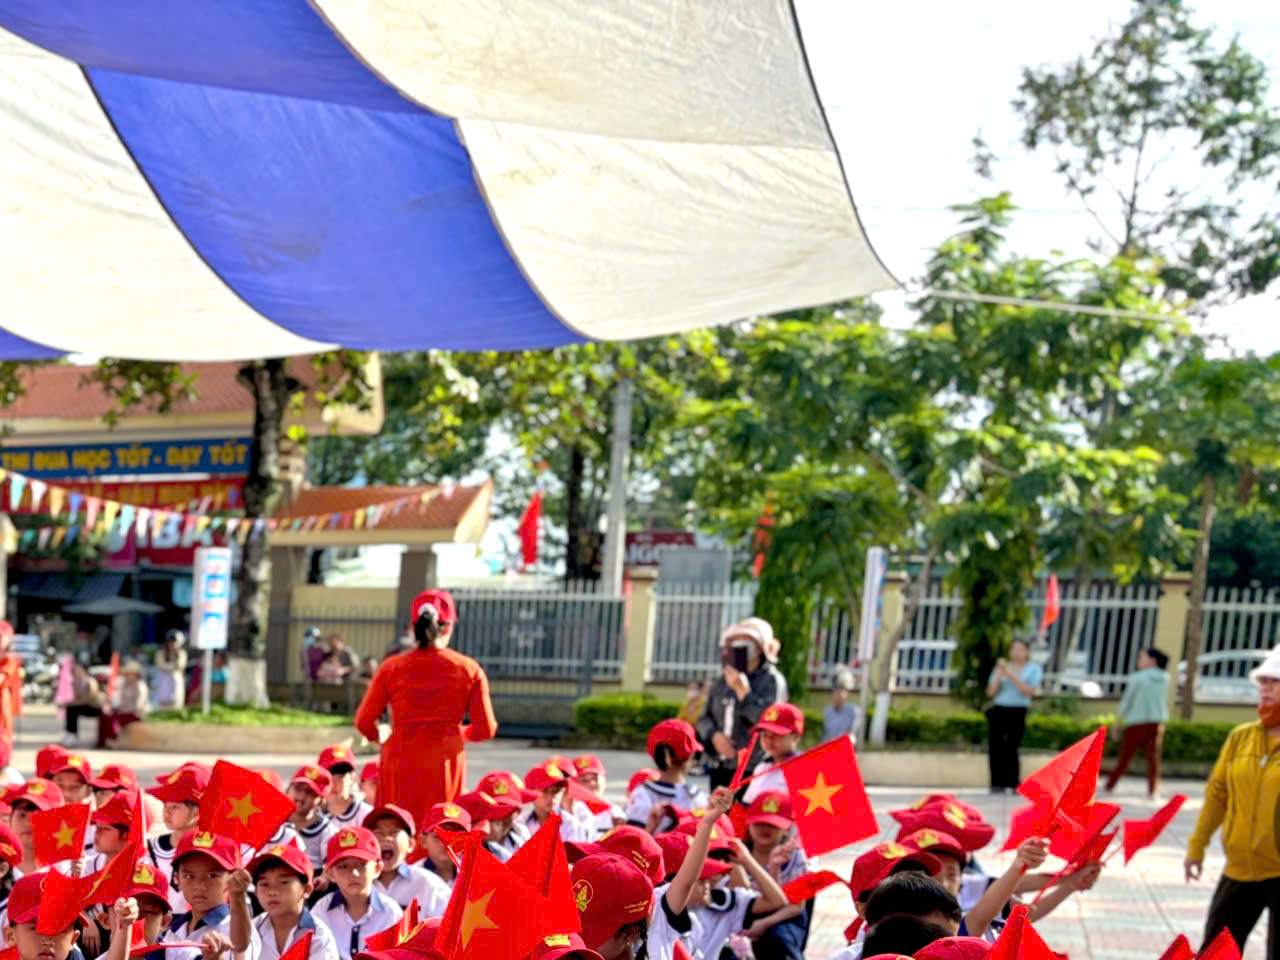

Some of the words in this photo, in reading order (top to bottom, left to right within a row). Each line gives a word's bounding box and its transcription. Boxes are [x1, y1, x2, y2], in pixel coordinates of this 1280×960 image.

[0, 452, 30, 470] THI
[72, 449, 111, 473] HỌC
[115, 443, 152, 467] TỐT
[209, 439, 248, 465] TỐT
